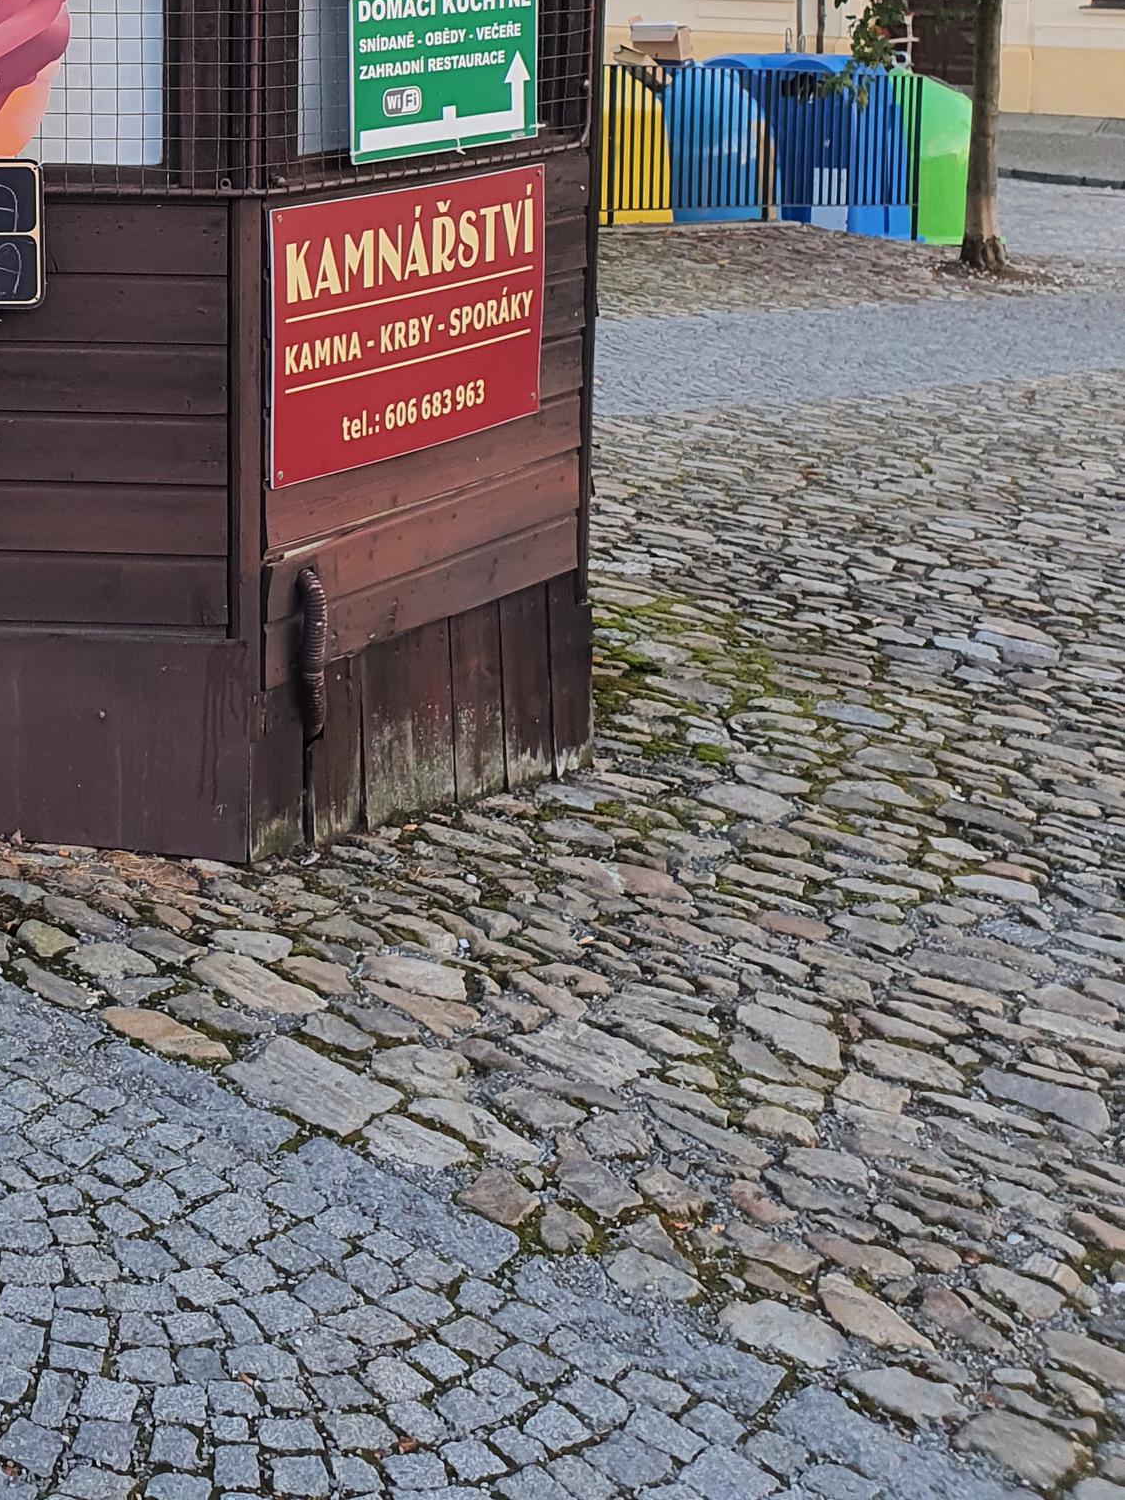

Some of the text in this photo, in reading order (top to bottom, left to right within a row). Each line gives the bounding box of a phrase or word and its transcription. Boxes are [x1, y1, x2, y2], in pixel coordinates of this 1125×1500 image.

[359, 31, 415, 53] SNÍDANĚ
[425, 27, 467, 47] OBĚDY
[476, 20, 522, 41] VEČEŘE
[359, 50, 505, 80] ZAHRADNÍ RESTAURACE
[285, 184, 534, 304] KAMNÁŘSTVÍ
[284, 331, 362, 375] KAMNA
[380, 314, 434, 354] KRBY
[449, 287, 534, 337] SPORÁKY
[341, 379, 486, 441] tel.: 606 683 963
